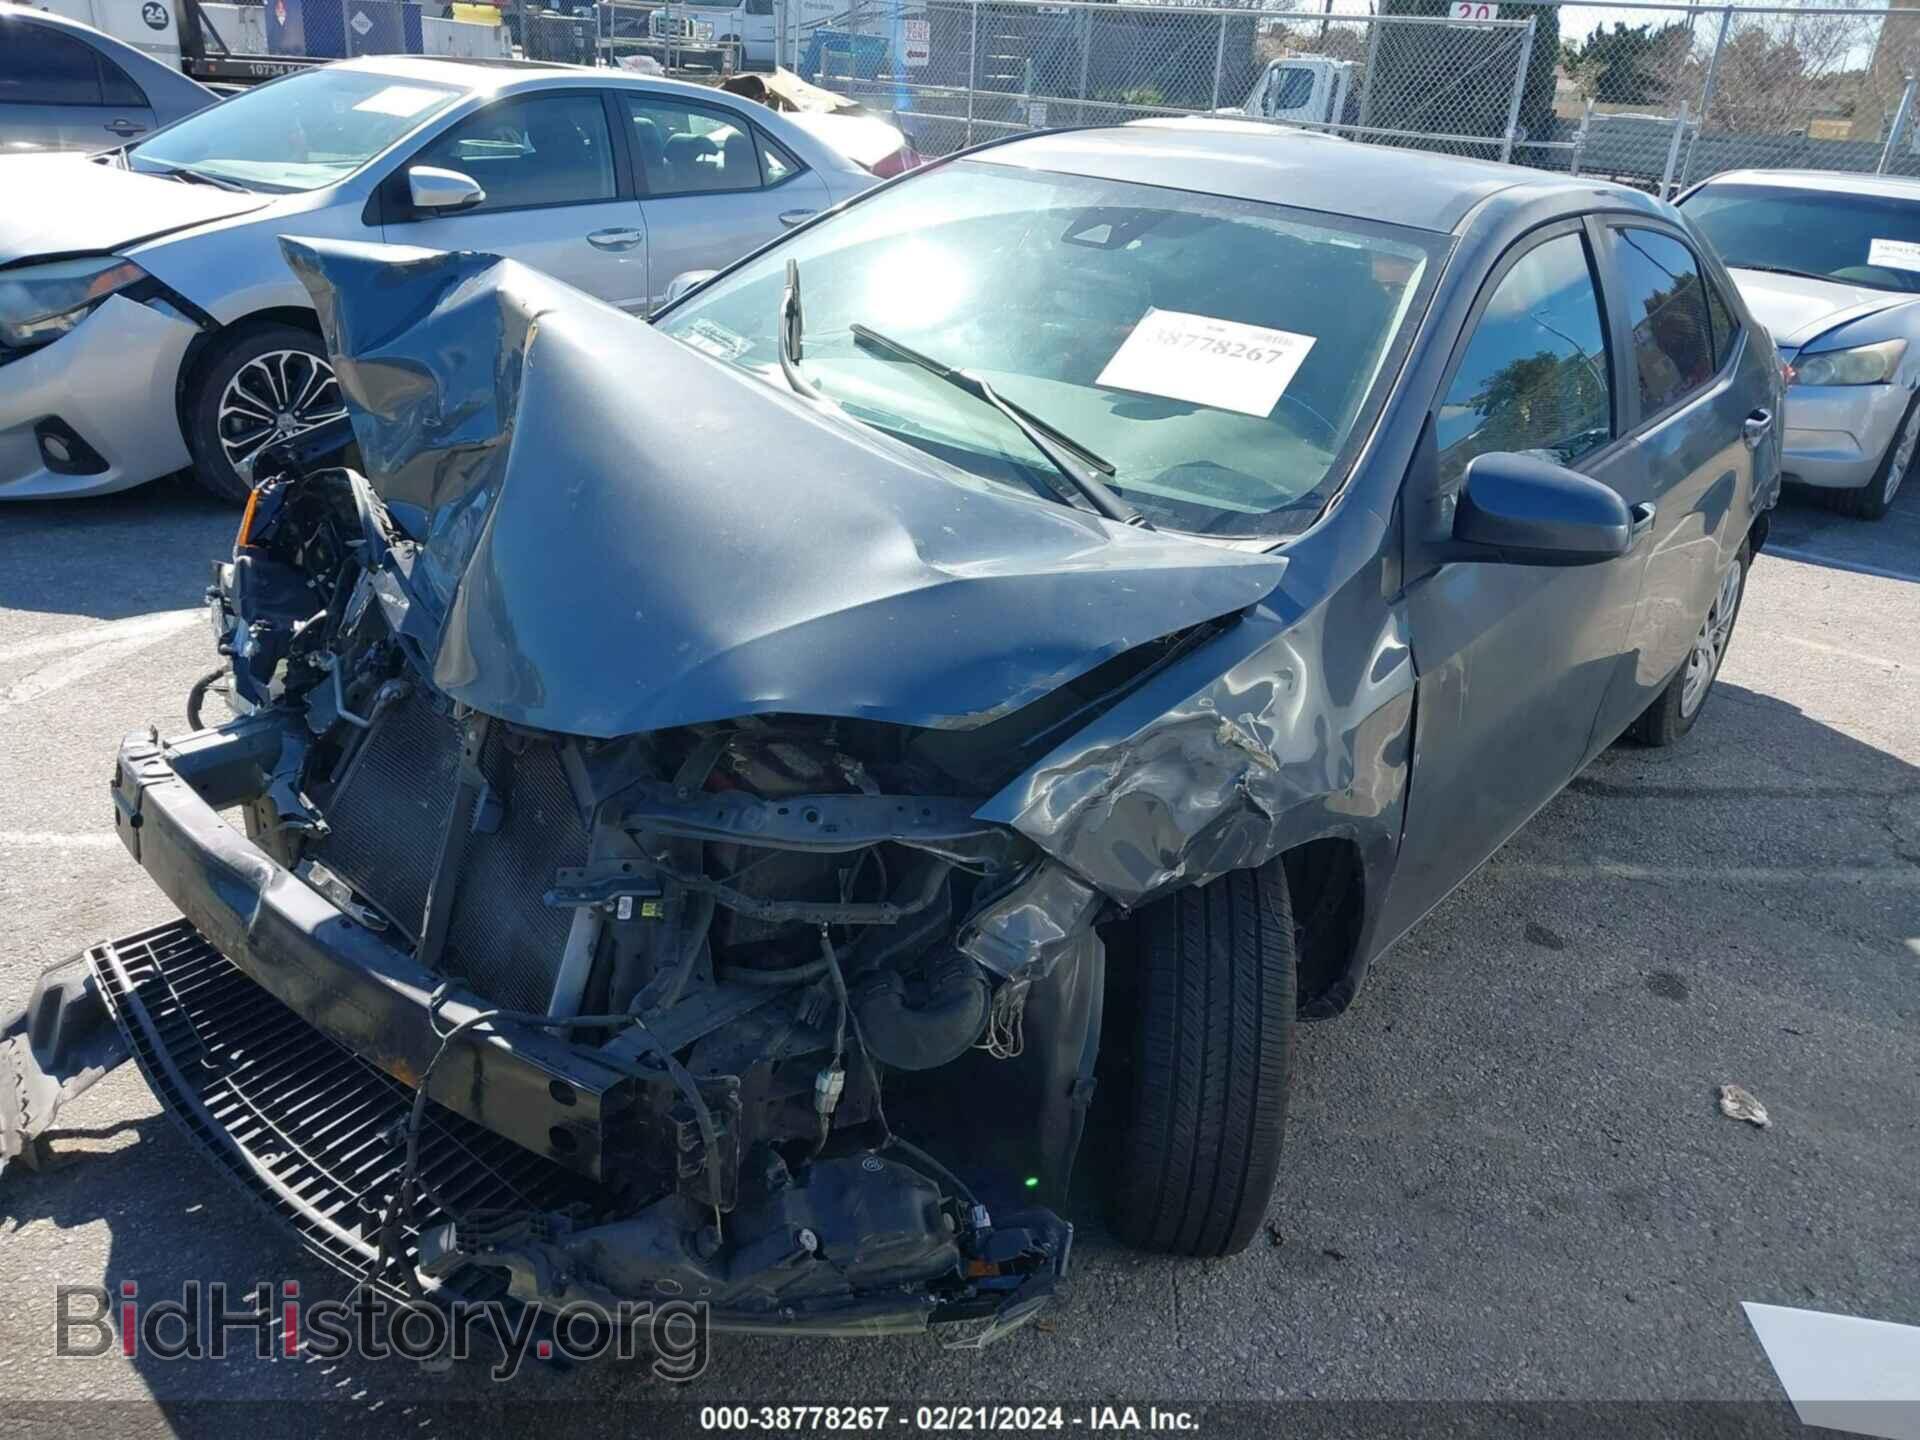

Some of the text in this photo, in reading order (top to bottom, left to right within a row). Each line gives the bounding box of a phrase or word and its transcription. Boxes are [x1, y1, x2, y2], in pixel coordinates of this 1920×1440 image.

[144, 6, 165, 20] 24
[249, 64, 285, 75] 10734
[1146, 327, 1284, 365] 38778267
